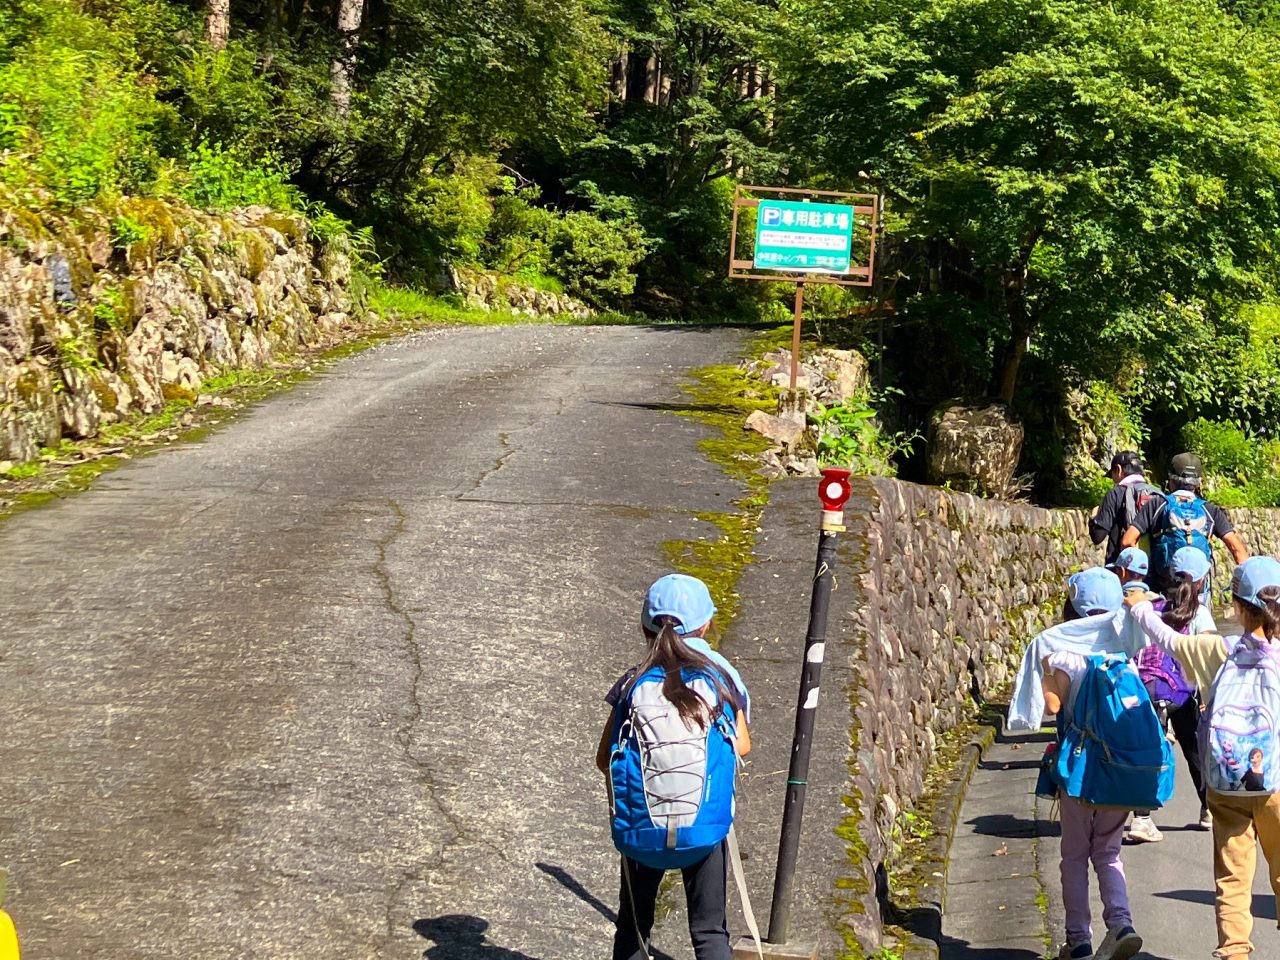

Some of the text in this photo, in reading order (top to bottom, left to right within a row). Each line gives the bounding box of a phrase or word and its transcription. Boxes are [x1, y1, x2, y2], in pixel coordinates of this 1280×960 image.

[763, 208, 849, 229] P 専用駐車場
